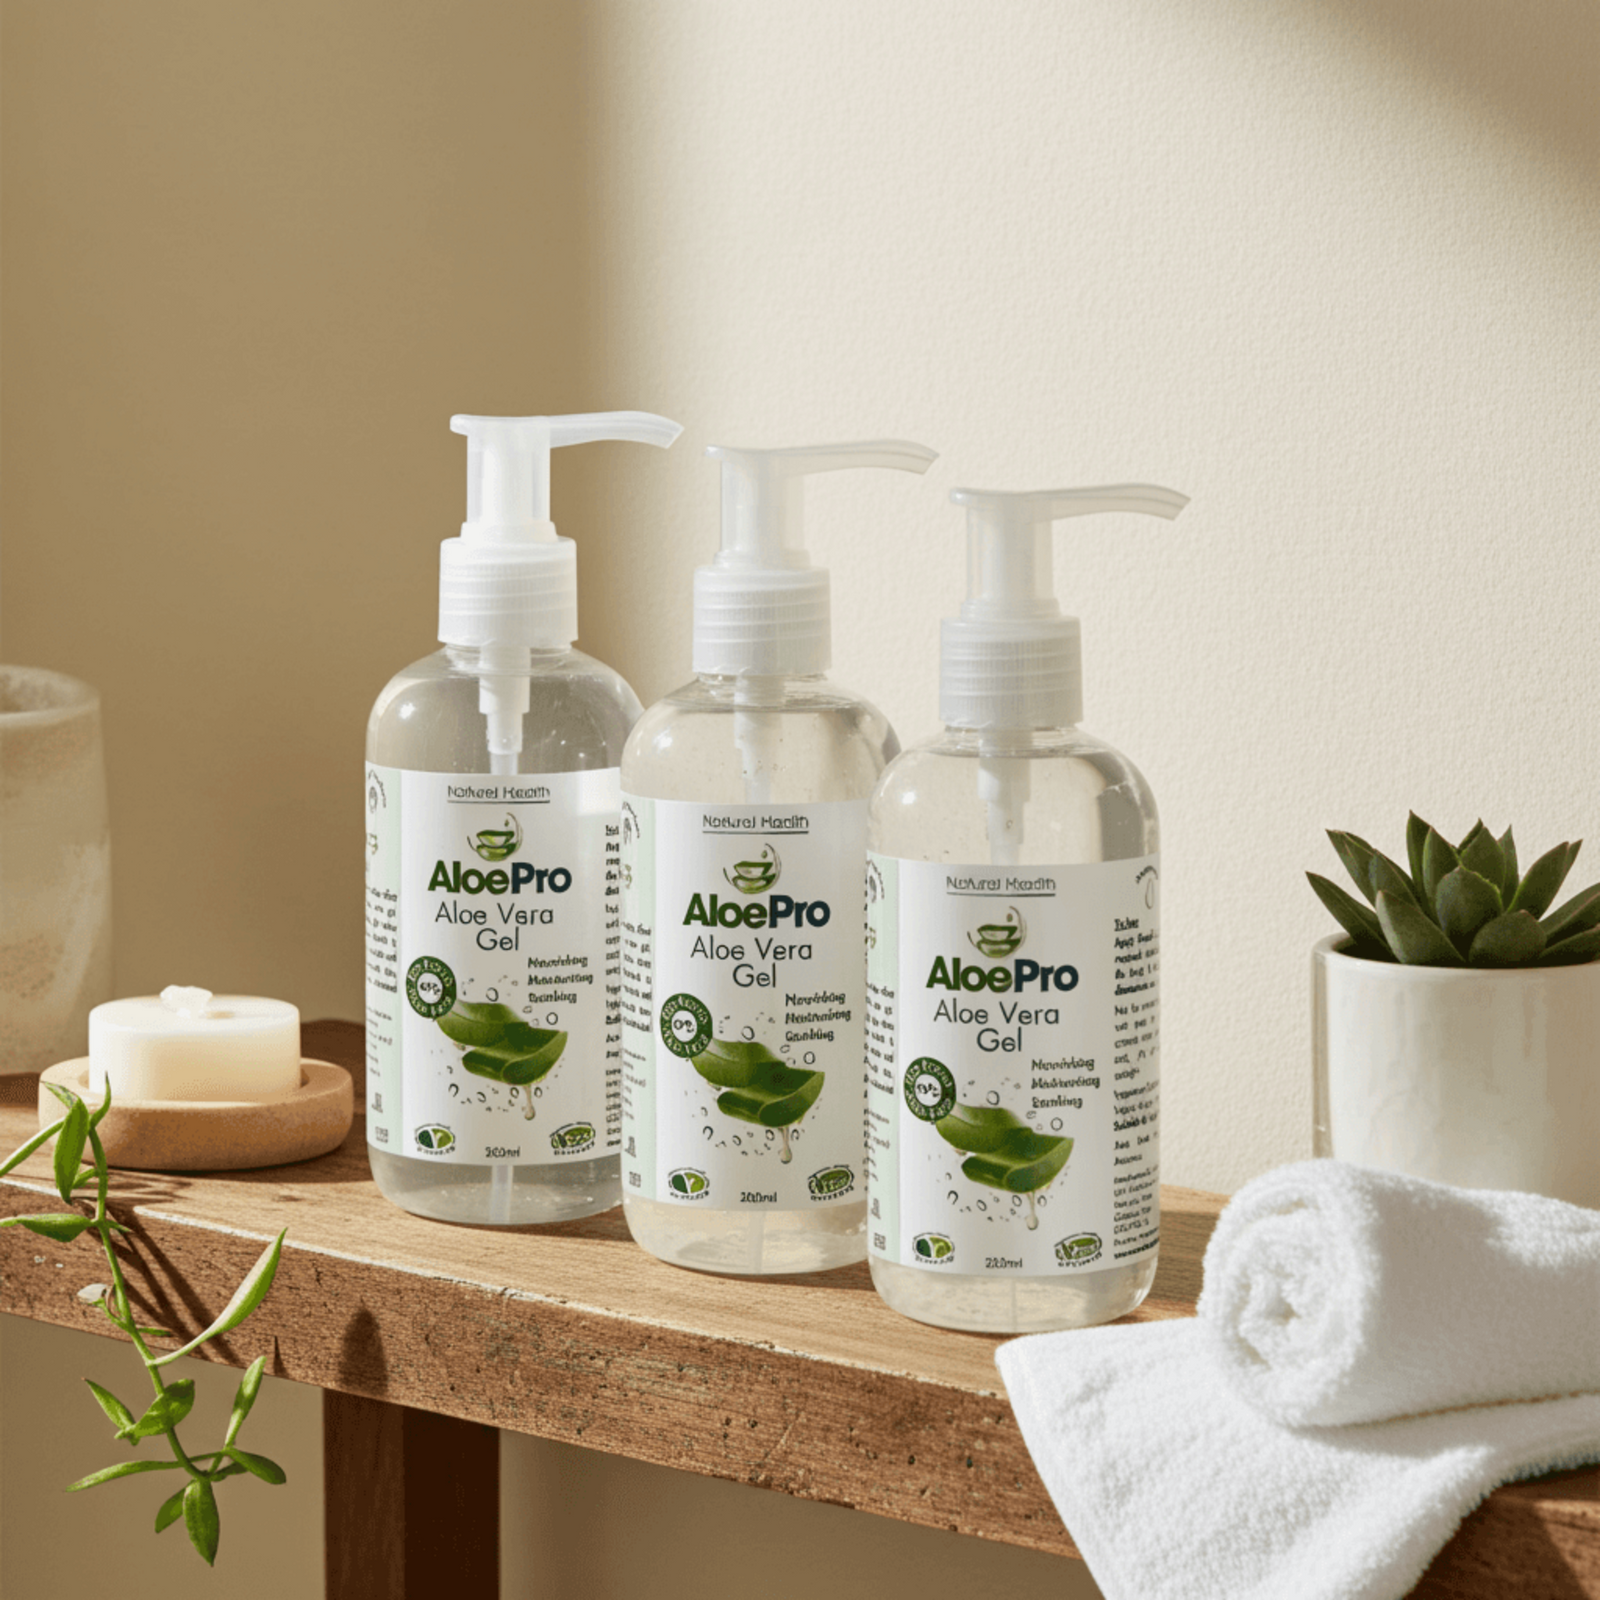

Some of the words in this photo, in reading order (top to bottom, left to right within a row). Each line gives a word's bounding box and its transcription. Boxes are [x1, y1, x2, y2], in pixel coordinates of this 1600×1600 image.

[427, 860, 572, 895] AloePro
[435, 900, 487, 925] Aloe
[497, 902, 554, 925] Vera
[682, 893, 831, 929] AloePro
[476, 926, 519, 951] Gel
[690, 934, 745, 960] Aloe
[754, 937, 812, 960] Vera
[732, 962, 776, 988] Gel
[926, 955, 1079, 993] AloePro
[933, 998, 988, 1024] Aloe
[999, 1001, 1060, 1025] Vera
[976, 1027, 1022, 1052] Gel
